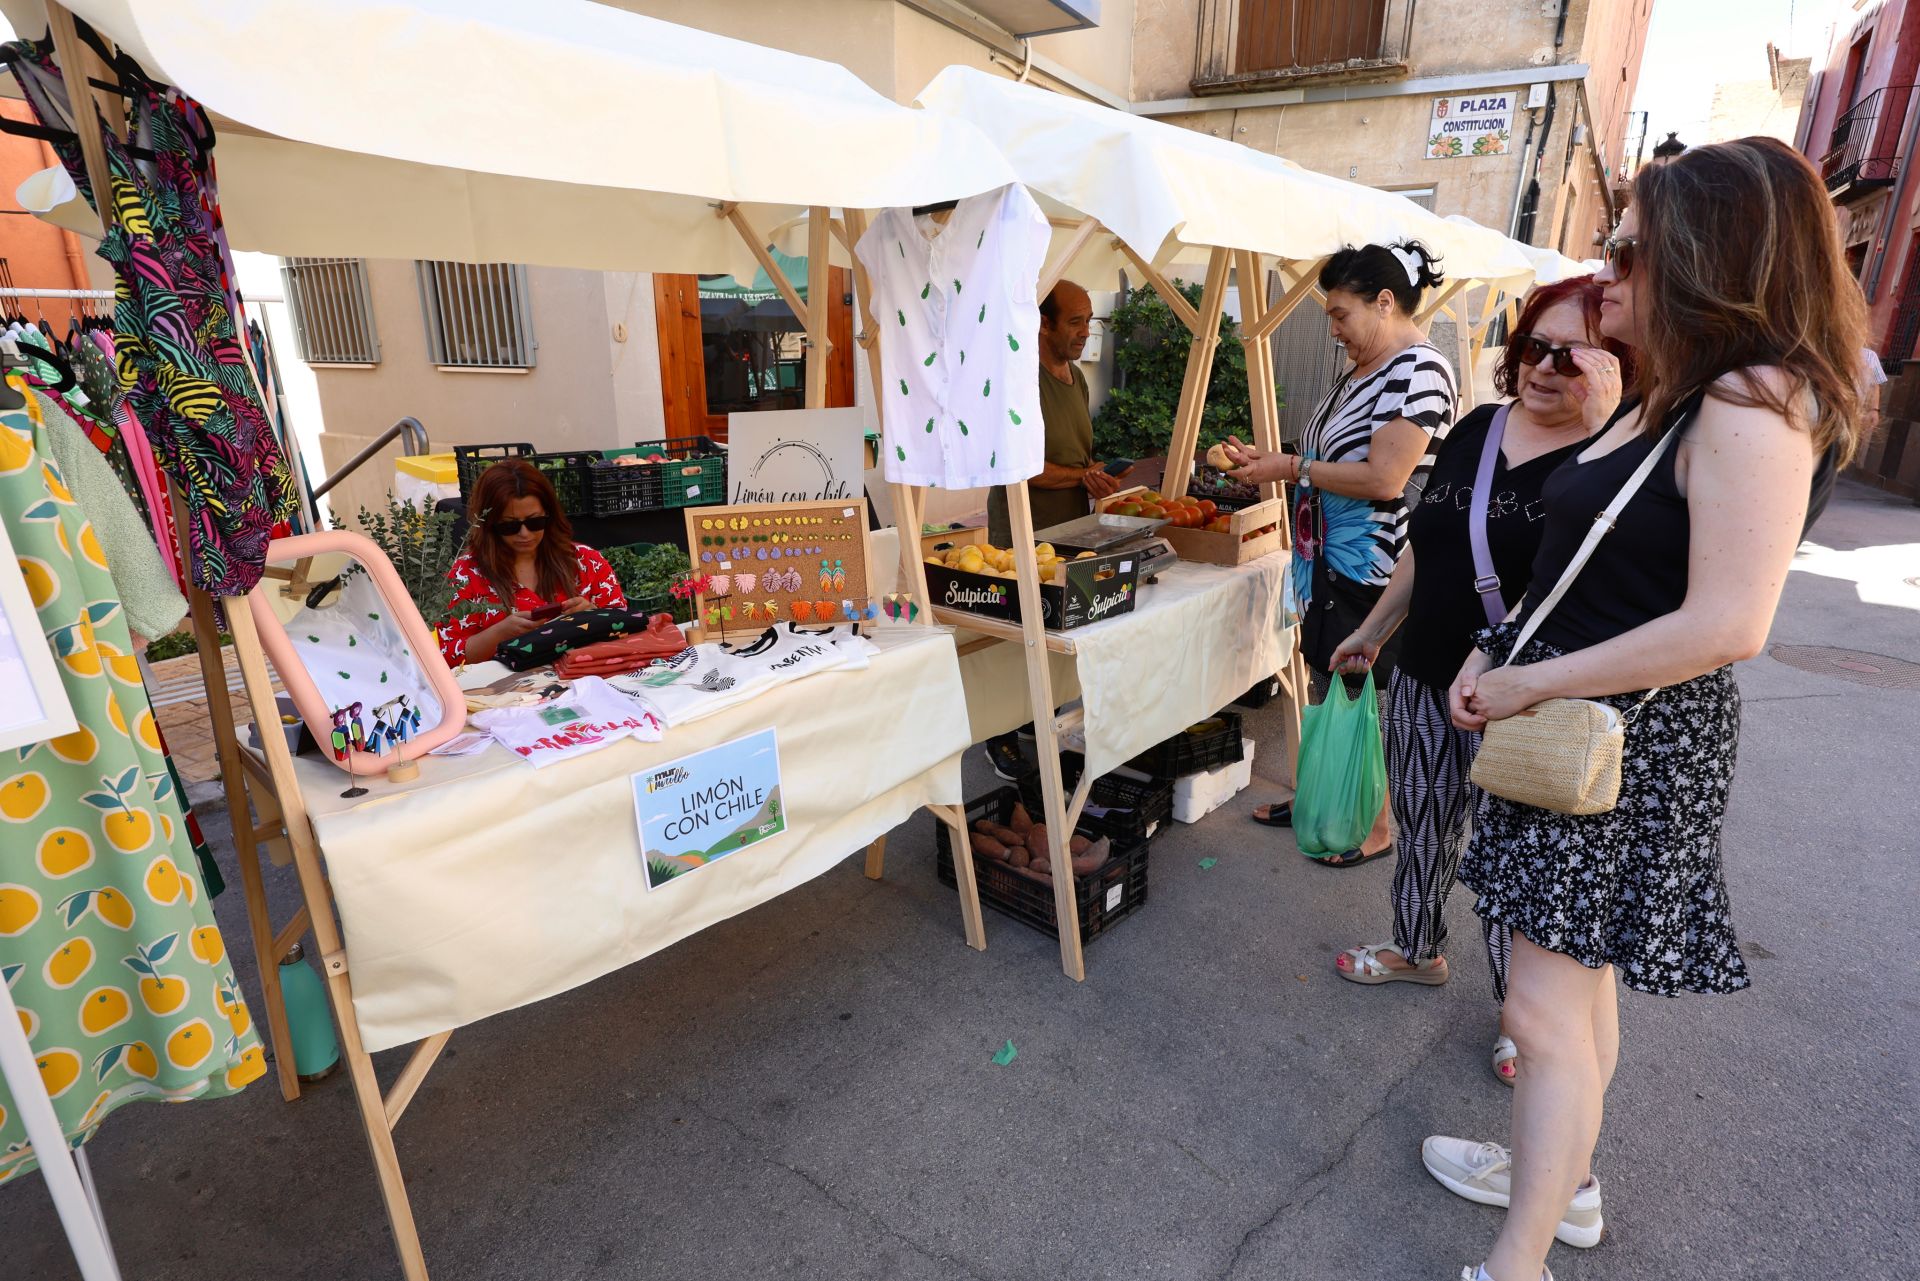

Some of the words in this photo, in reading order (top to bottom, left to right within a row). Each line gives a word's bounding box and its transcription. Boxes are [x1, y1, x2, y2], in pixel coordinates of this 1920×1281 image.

[1459, 97, 1507, 112] PLAZA
[1442, 118, 1506, 132] CONSTITUCION
[1350, 167, 1357, 177] 8
[733, 481, 774, 505] Limón
[782, 491, 807, 502] con
[945, 580, 1001, 608] Sulpicia
[1087, 589, 1128, 619] Sulpicia
[654, 767, 676, 782] mur
[681, 775, 744, 814] LIMÓN
[664, 809, 710, 841] CON
[714, 787, 764, 821] CHILE
